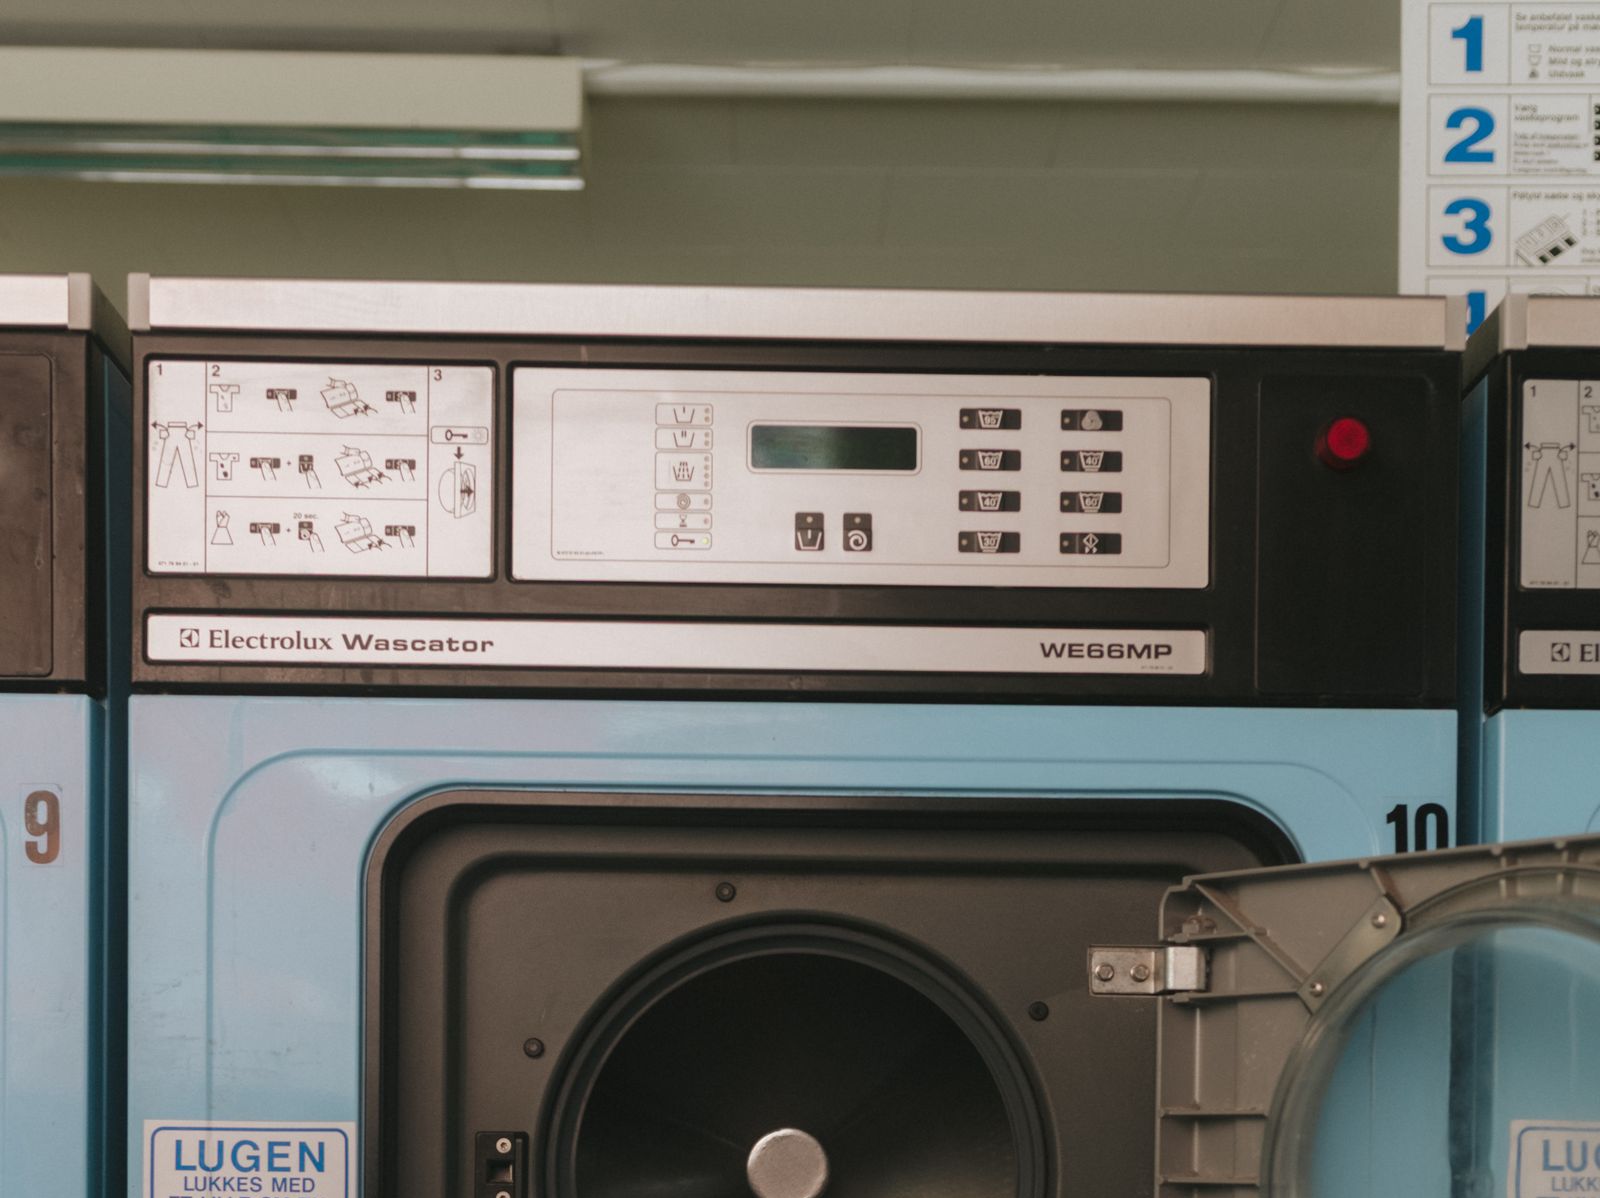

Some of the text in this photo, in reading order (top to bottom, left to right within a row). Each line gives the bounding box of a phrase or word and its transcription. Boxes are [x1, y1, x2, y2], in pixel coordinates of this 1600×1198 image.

[1451, 14, 1484, 72] 1
[1444, 107, 1496, 163] 2
[1441, 197, 1493, 254] 3
[156, 364, 164, 376] 1
[211, 365, 221, 377] 2
[433, 369, 443, 381] 3
[1530, 385, 1537, 398] 1
[1584, 386, 1594, 399] 2
[209, 629, 495, 653] Electrolux Wascator
[1040, 641, 1174, 660] WE66MP
[24, 790, 61, 864] 9
[1386, 802, 1449, 854] 10
[174, 1139, 326, 1173] LUGEN
[183, 1176, 316, 1193] LUKKES MED
